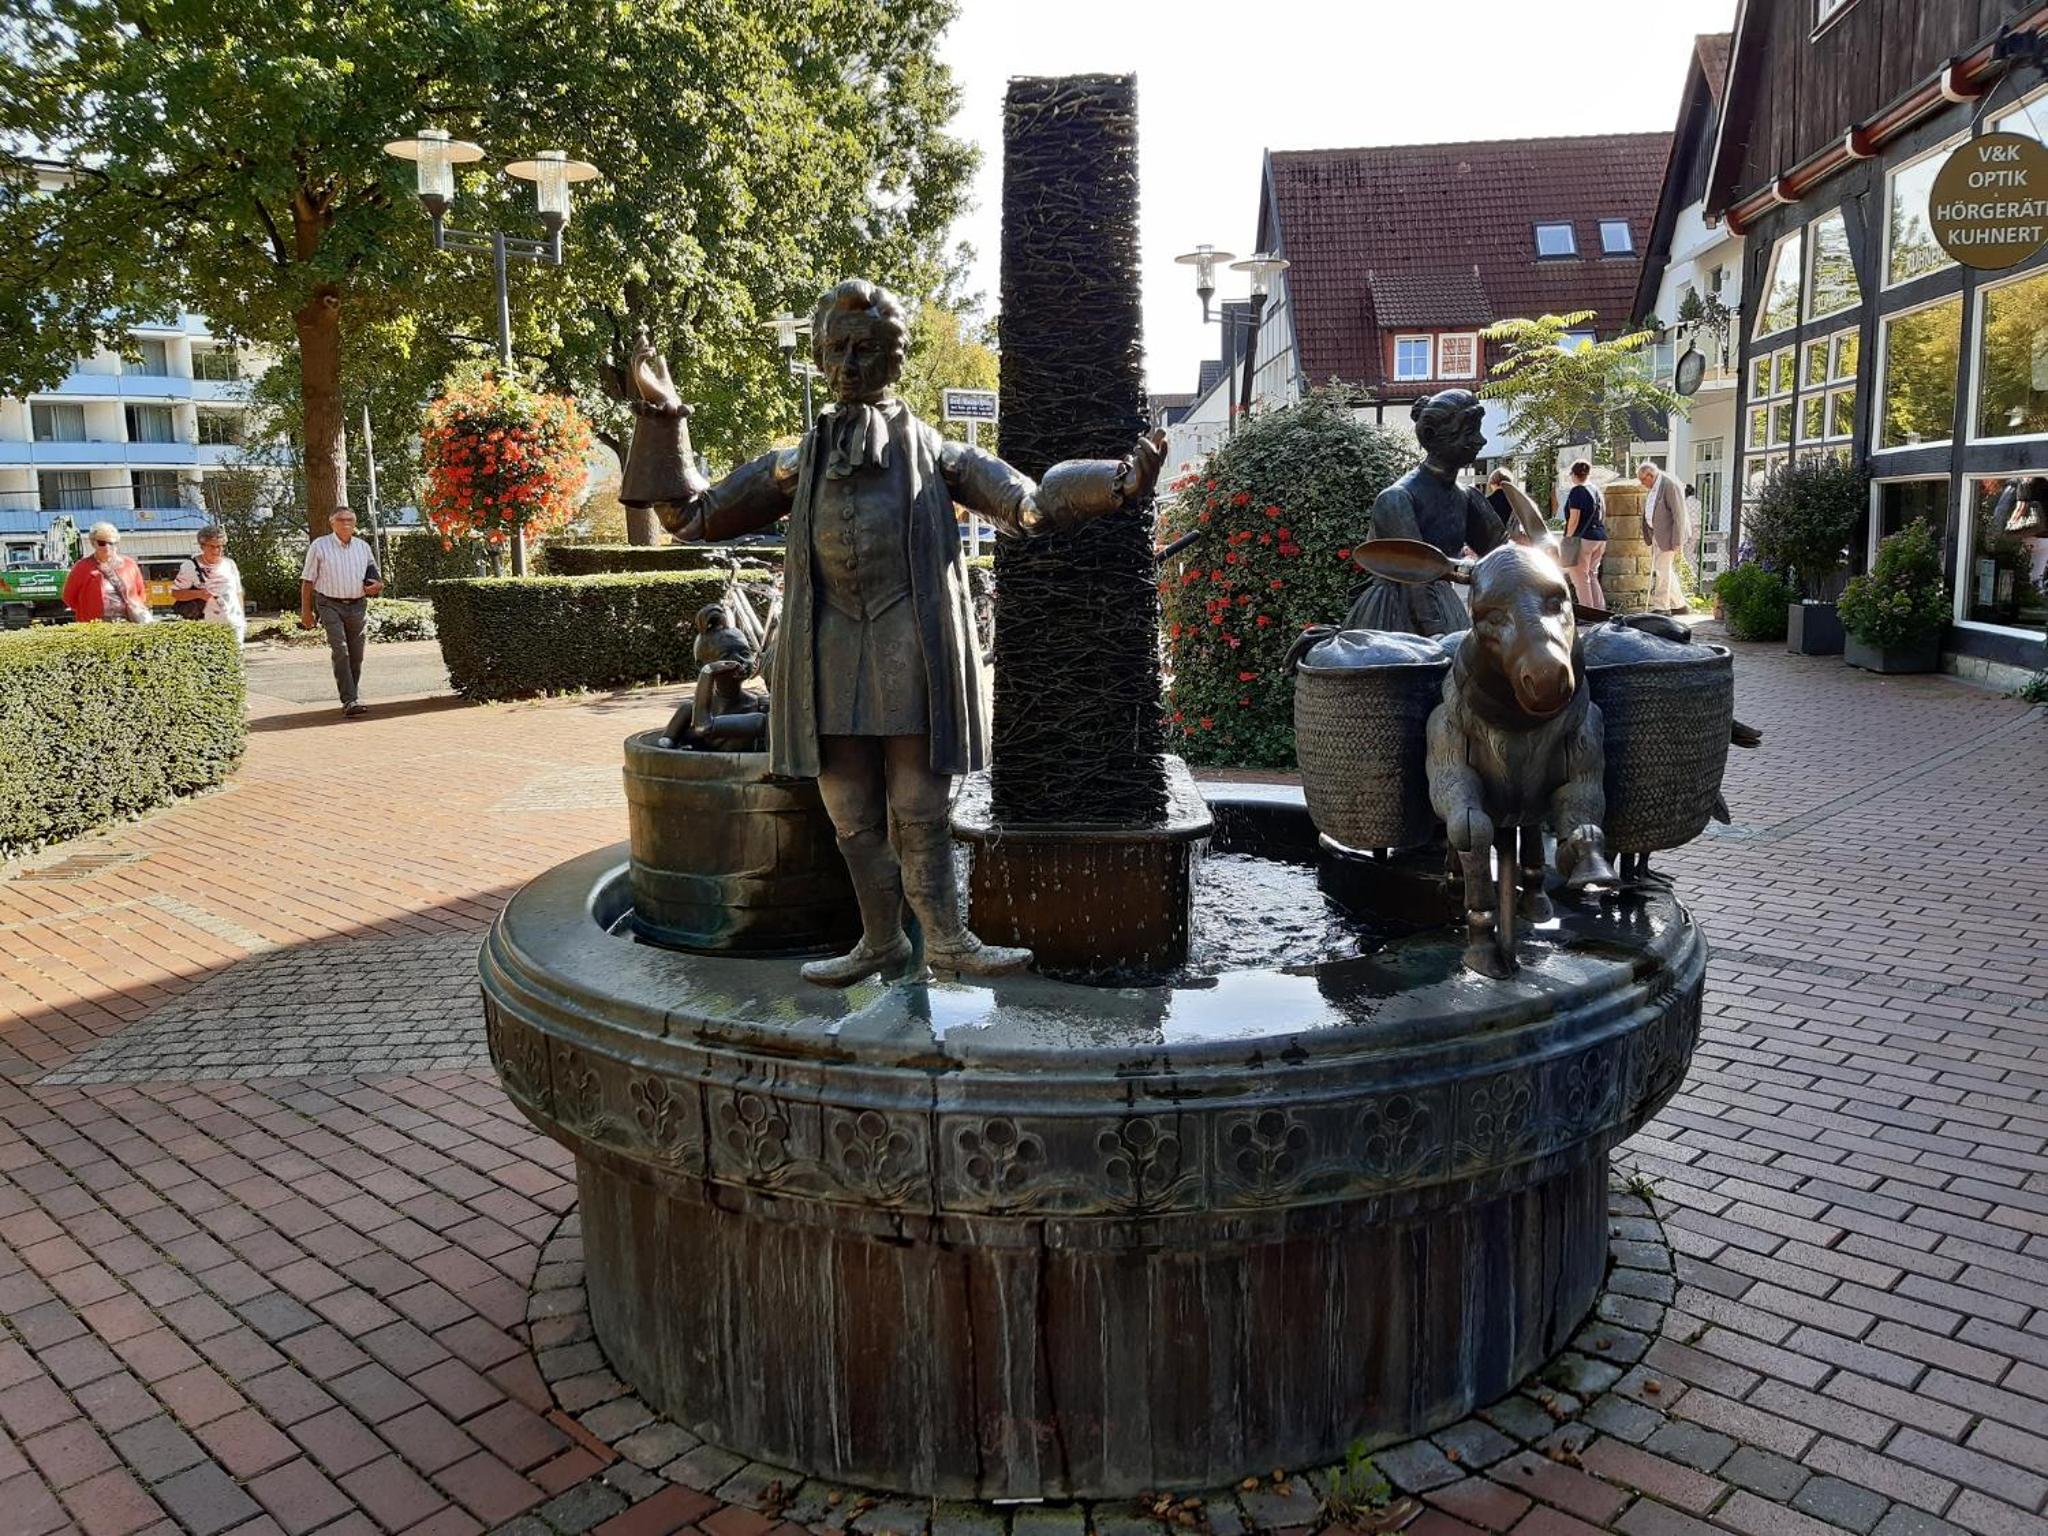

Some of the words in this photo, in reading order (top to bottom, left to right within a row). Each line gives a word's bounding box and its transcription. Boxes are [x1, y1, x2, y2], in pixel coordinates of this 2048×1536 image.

[1979, 144, 2021, 162] V&K
[1968, 169, 2028, 188] OPTIK
[1937, 197, 2048, 220] HÖRGERÄT
[1948, 225, 2043, 245] KUHNERT
